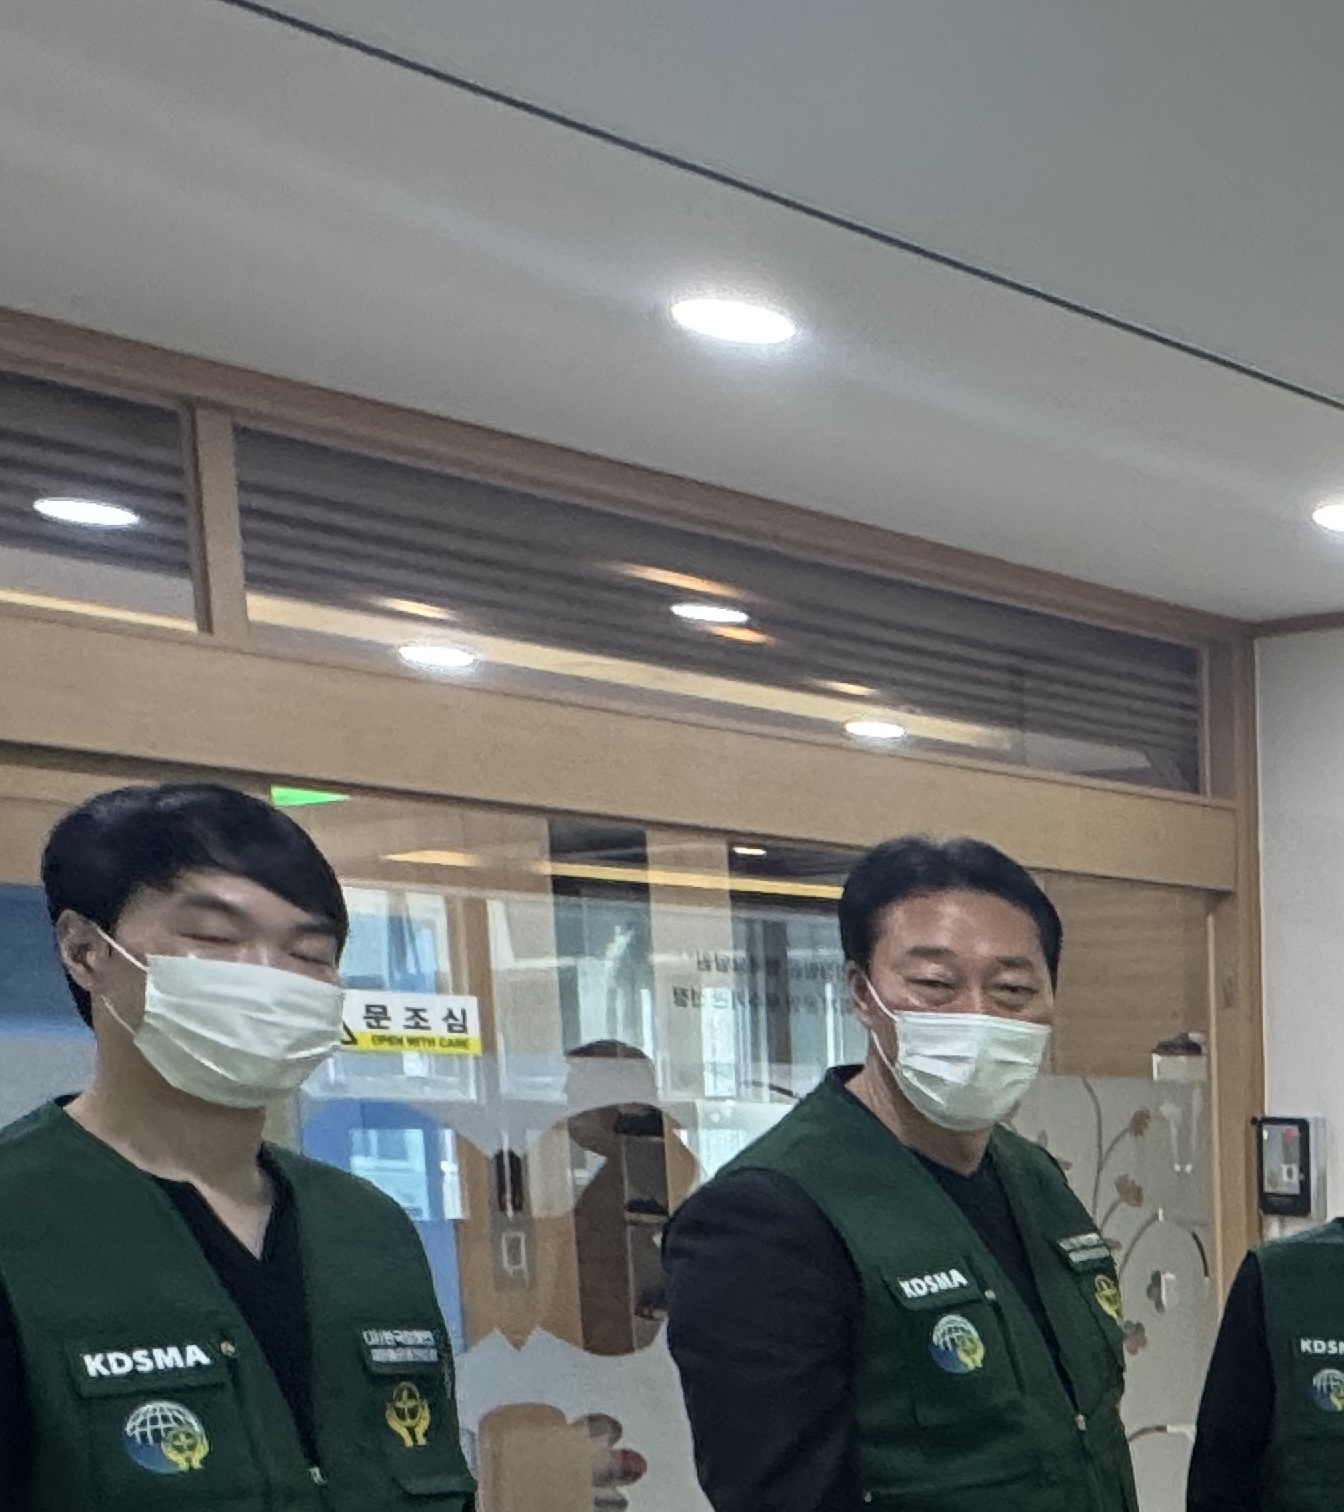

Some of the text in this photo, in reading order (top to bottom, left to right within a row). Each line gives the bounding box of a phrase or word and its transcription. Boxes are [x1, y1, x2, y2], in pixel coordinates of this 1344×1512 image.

[406, 1036, 435, 1047] WITH
[900, 1268, 968, 1298] KDSMA
[83, 1344, 211, 1377] KDSMA
